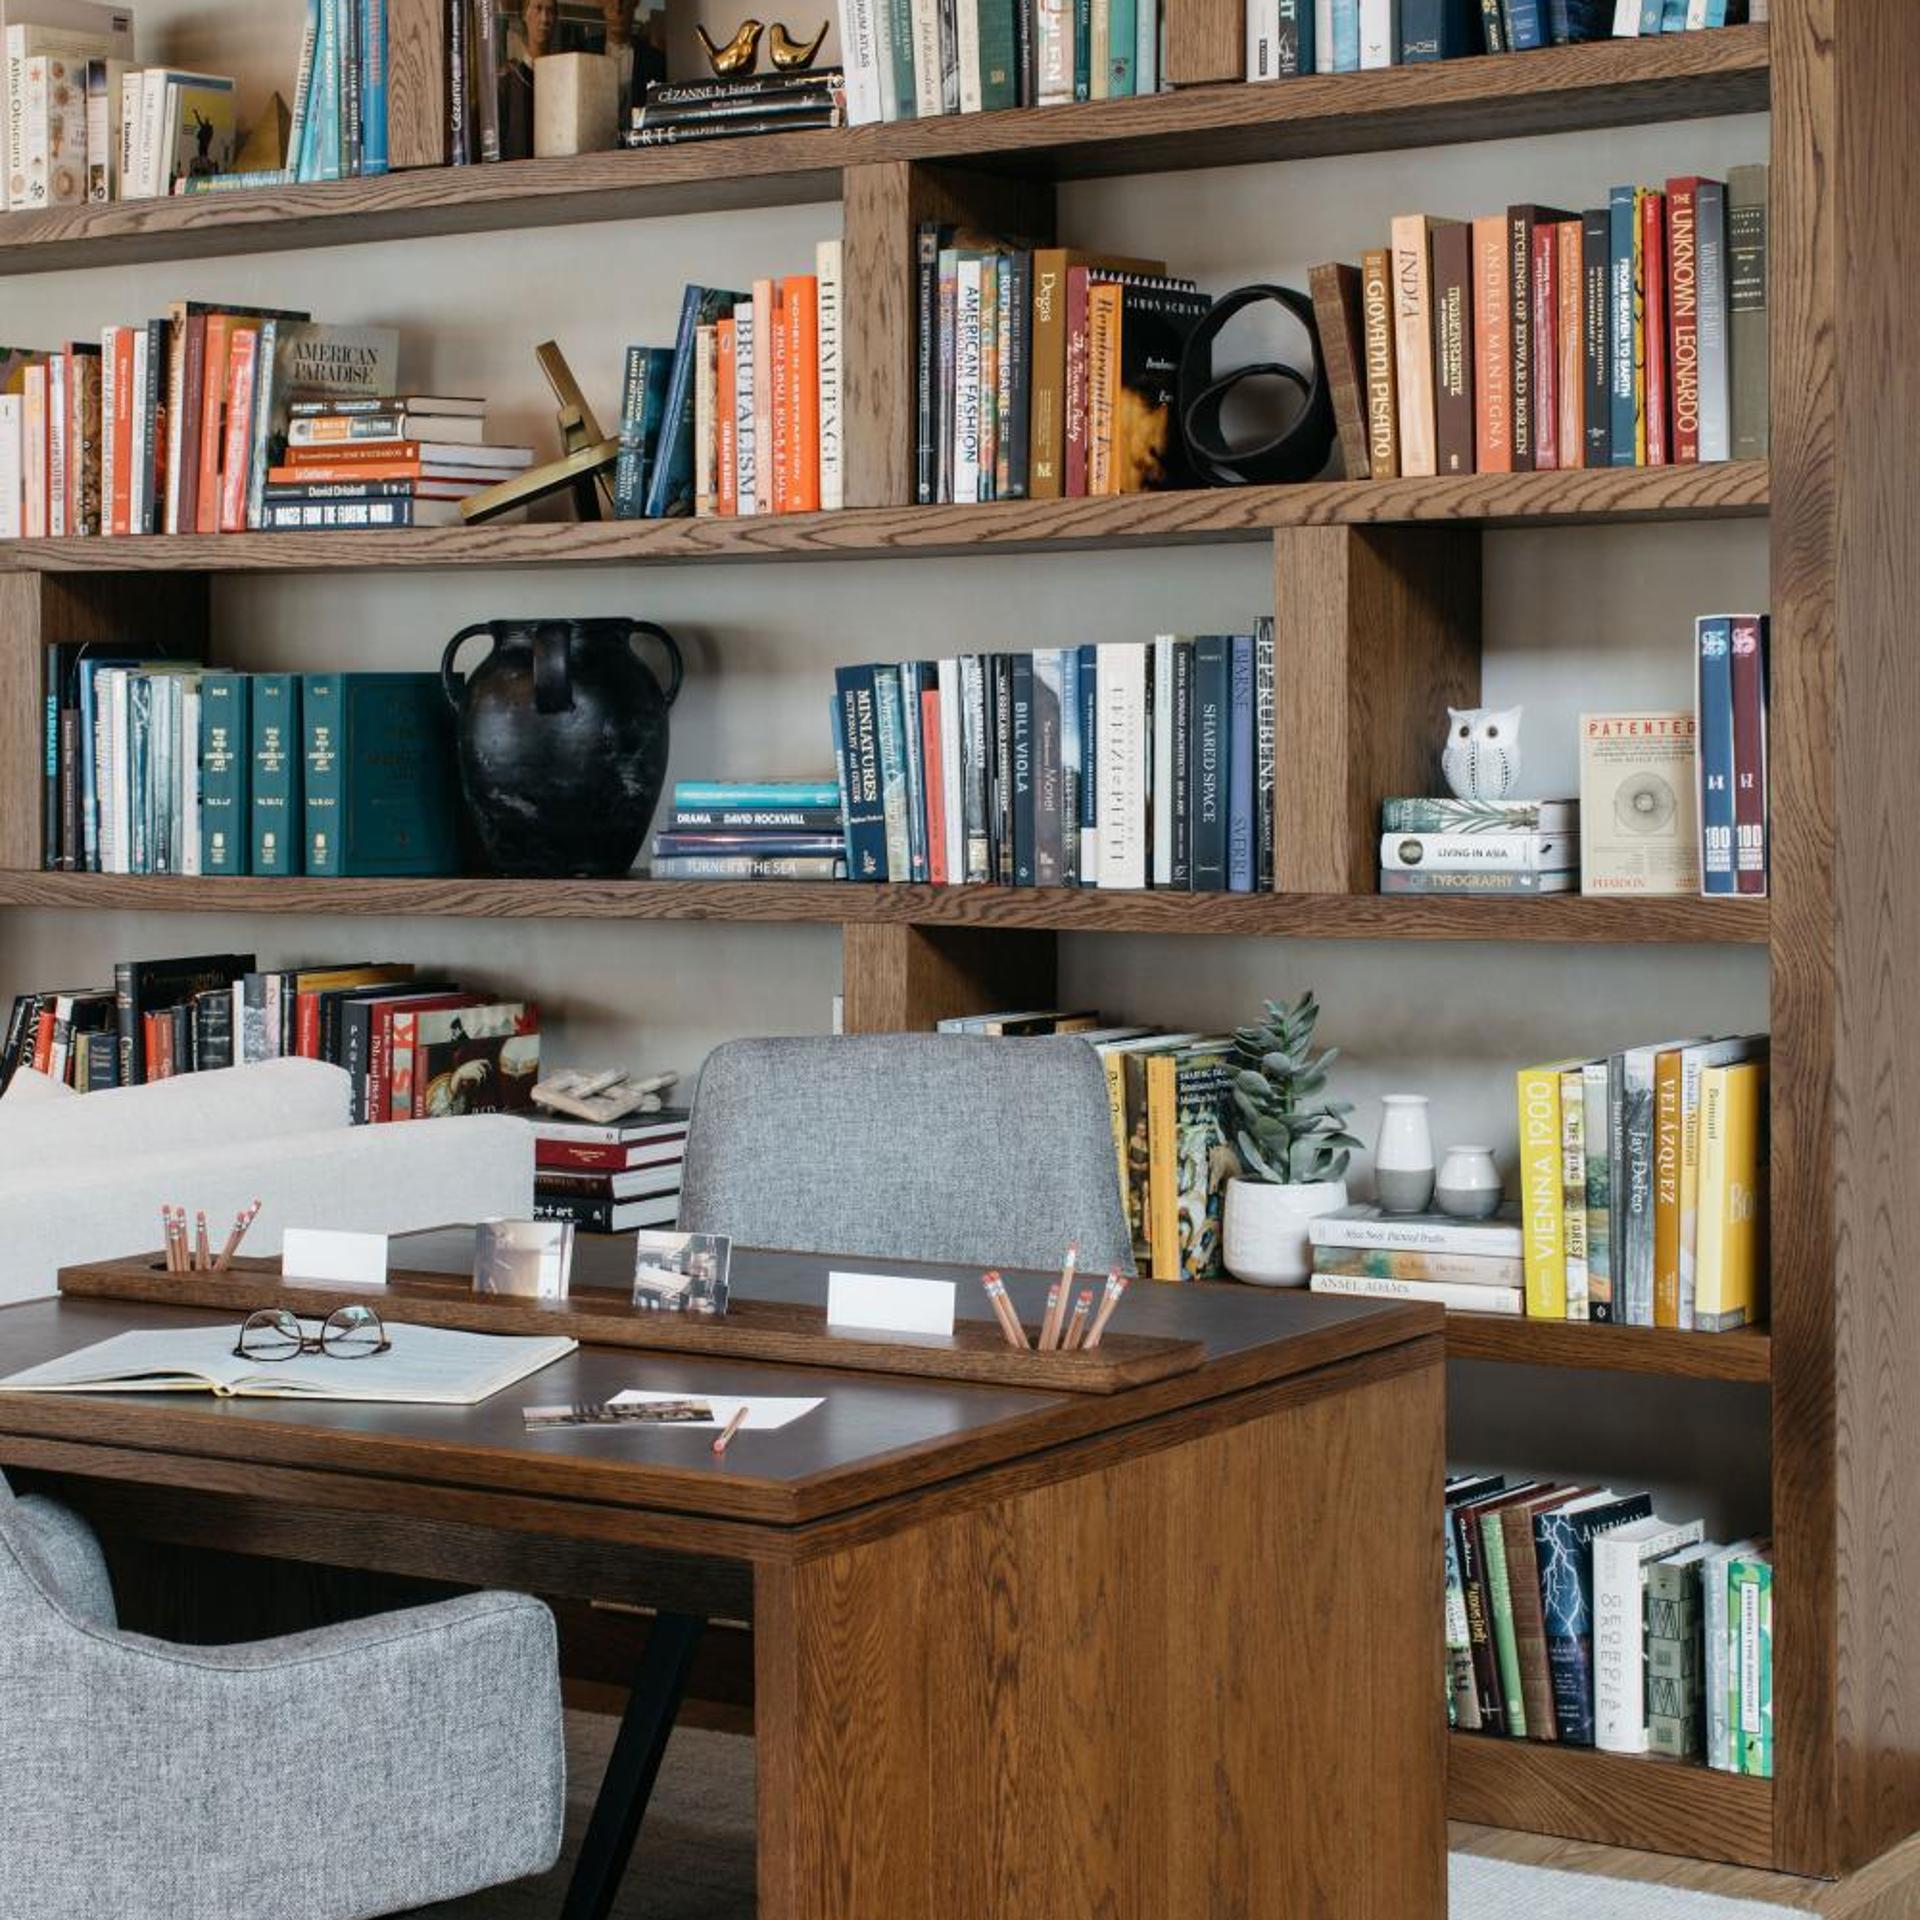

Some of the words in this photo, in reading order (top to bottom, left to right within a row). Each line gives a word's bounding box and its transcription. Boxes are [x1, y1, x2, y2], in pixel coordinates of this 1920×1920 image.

[1487, 242, 1502, 324] ANDREA
[1514, 219, 1526, 297] ETCHINGS
[1620, 258, 1631, 292] FROM
[1672, 210, 1694, 316] UNKNOWN
[999, 276, 1010, 315] RUTH
[1036, 272, 1055, 322] Degas
[1399, 249, 1420, 318] INDIA
[791, 293, 800, 347] WOMEN
[964, 286, 978, 377] AMERICAN
[1514, 300, 1526, 320] OF
[1620, 294, 1631, 340] HEAVEN
[293, 343, 379, 366] AMERICAN
[293, 362, 375, 385] PARADISE
[791, 355, 800, 368] IN
[1514, 324, 1526, 393] EDWARD
[1620, 342, 1631, 357] TO
[634, 379, 645, 422] CLINTON
[1487, 330, 1502, 449] MANTEGNA
[1620, 359, 1631, 398] EARTH
[1675, 325, 1697, 433] LEONARDO
[737, 319, 756, 496] BRUTALISM
[962, 385, 977, 463] FASHION
[1370, 382, 1391, 458] PISANO
[308, 485, 333, 498] David
[845, 690, 858, 750] DICTIONARY
[1016, 702, 1028, 739] BILL
[1203, 703, 1216, 770] SHARED
[1258, 687, 1276, 792] RUBENS
[1588, 721, 1697, 735] PATENTED
[857, 689, 877, 802] MINIATURES
[1016, 742, 1028, 793] VIOLA
[1044, 767, 1057, 811] Monet
[1203, 773, 1216, 823] SPACE
[677, 813, 711, 825] DRAMA
[723, 814, 753, 825] DAVID
[755, 814, 805, 825] ROCKWELL
[1706, 826, 1730, 848] 100
[1737, 824, 1762, 847] 100
[746, 861, 770, 875] THE
[772, 860, 797, 874] SEA
[1438, 848, 1471, 858] LIVING
[1473, 849, 1483, 858] IN
[1486, 849, 1508, 859] ASIA
[1431, 873, 1513, 887] TYPOGRAPHY
[119, 1036, 133, 1087] Carav
[1526, 1081, 1553, 1148] 1900
[1568, 1122, 1579, 1141] THE
[1658, 1078, 1677, 1204] VELÁZQUEZ
[1533, 1154, 1556, 1261] VIENNA
[1320, 1278, 1357, 1290] ANSEL
[1366, 1280, 1409, 1293] ADAMS
[1610, 1595, 1622, 1710] GEORGIA
